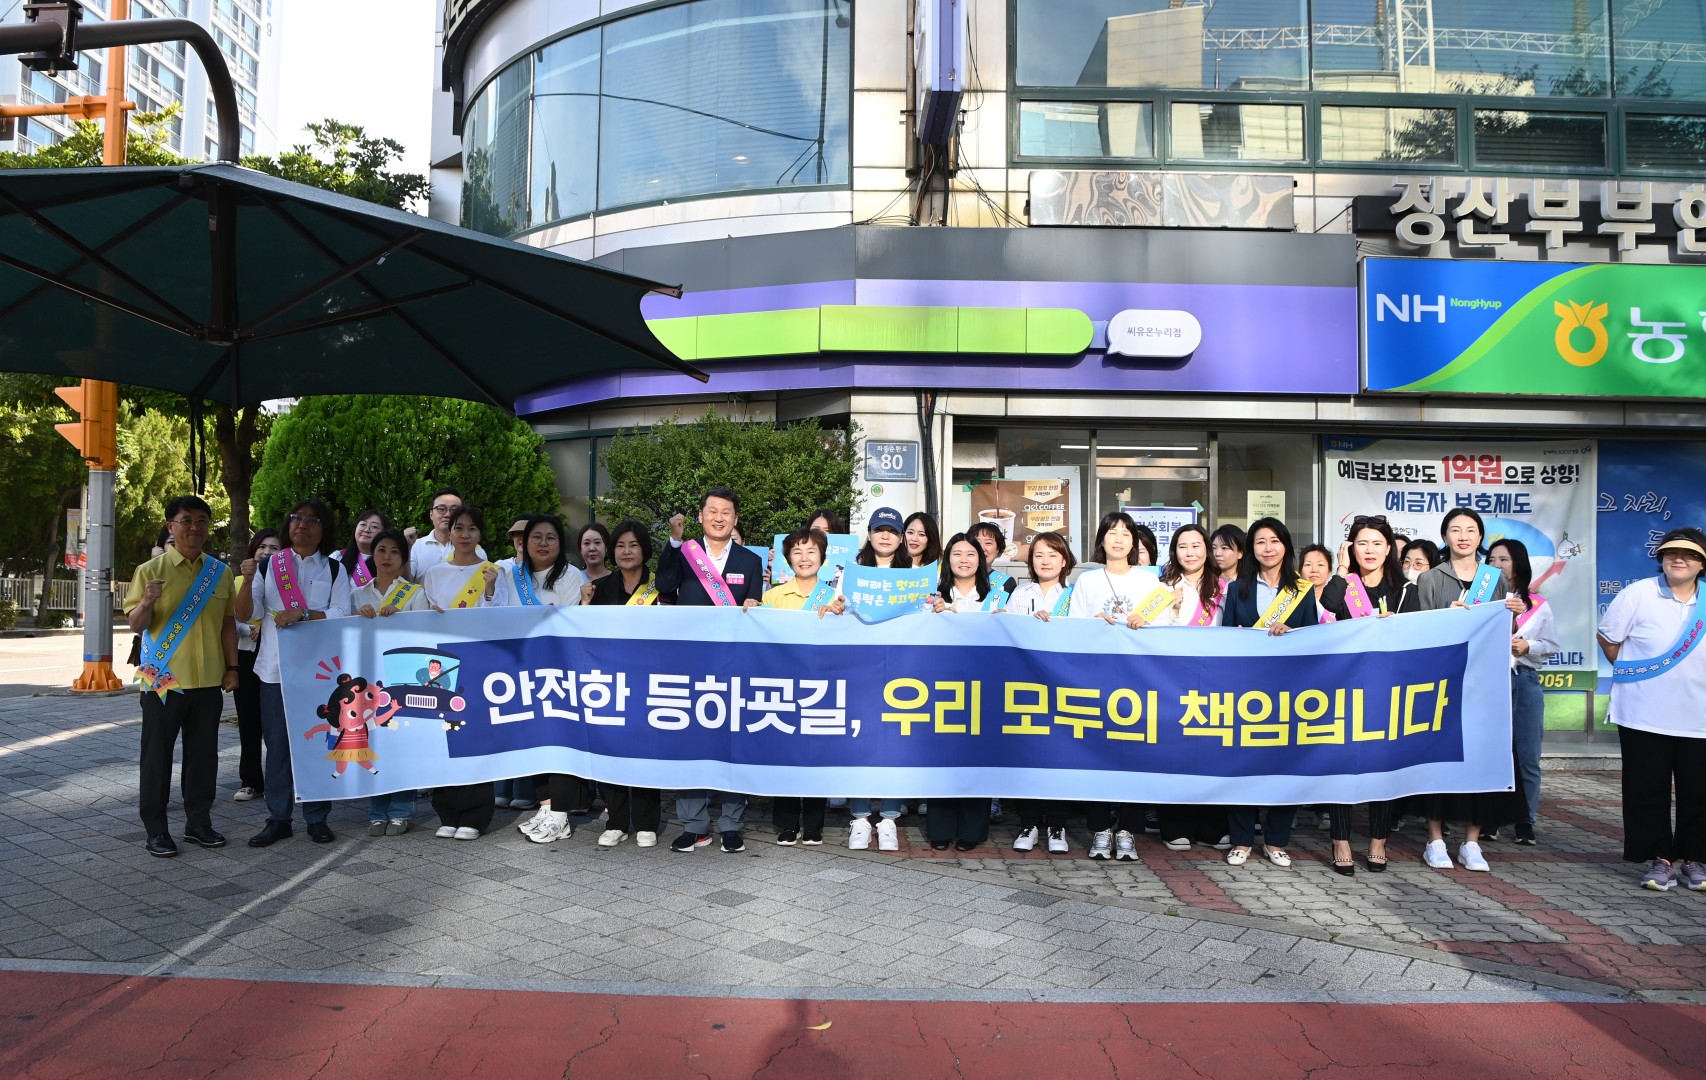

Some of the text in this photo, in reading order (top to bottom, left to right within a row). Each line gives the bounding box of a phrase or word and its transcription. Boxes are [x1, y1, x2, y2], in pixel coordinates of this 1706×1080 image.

[1376, 293, 1502, 324] NH NongHyup
[1126, 326, 1182, 338] 씨유온누리점
[1627, 307, 1706, 364] 농
[1338, 440, 1353, 450] NH
[880, 453, 904, 470] 80
[1337, 458, 1438, 484] 예금보호한도
[1539, 463, 1580, 485] 상향!
[1384, 490, 1533, 515] 예금자 보호제도
[1623, 490, 1672, 520] 자리,
[856, 577, 893, 592] 배려는
[852, 591, 885, 608] 폭력은
[155, 622, 183, 660] 행복하다
[1541, 651, 1585, 666] 립니다
[482, 667, 1449, 747] 안전한 등하굣길, 우리 모두의 책임입니다
